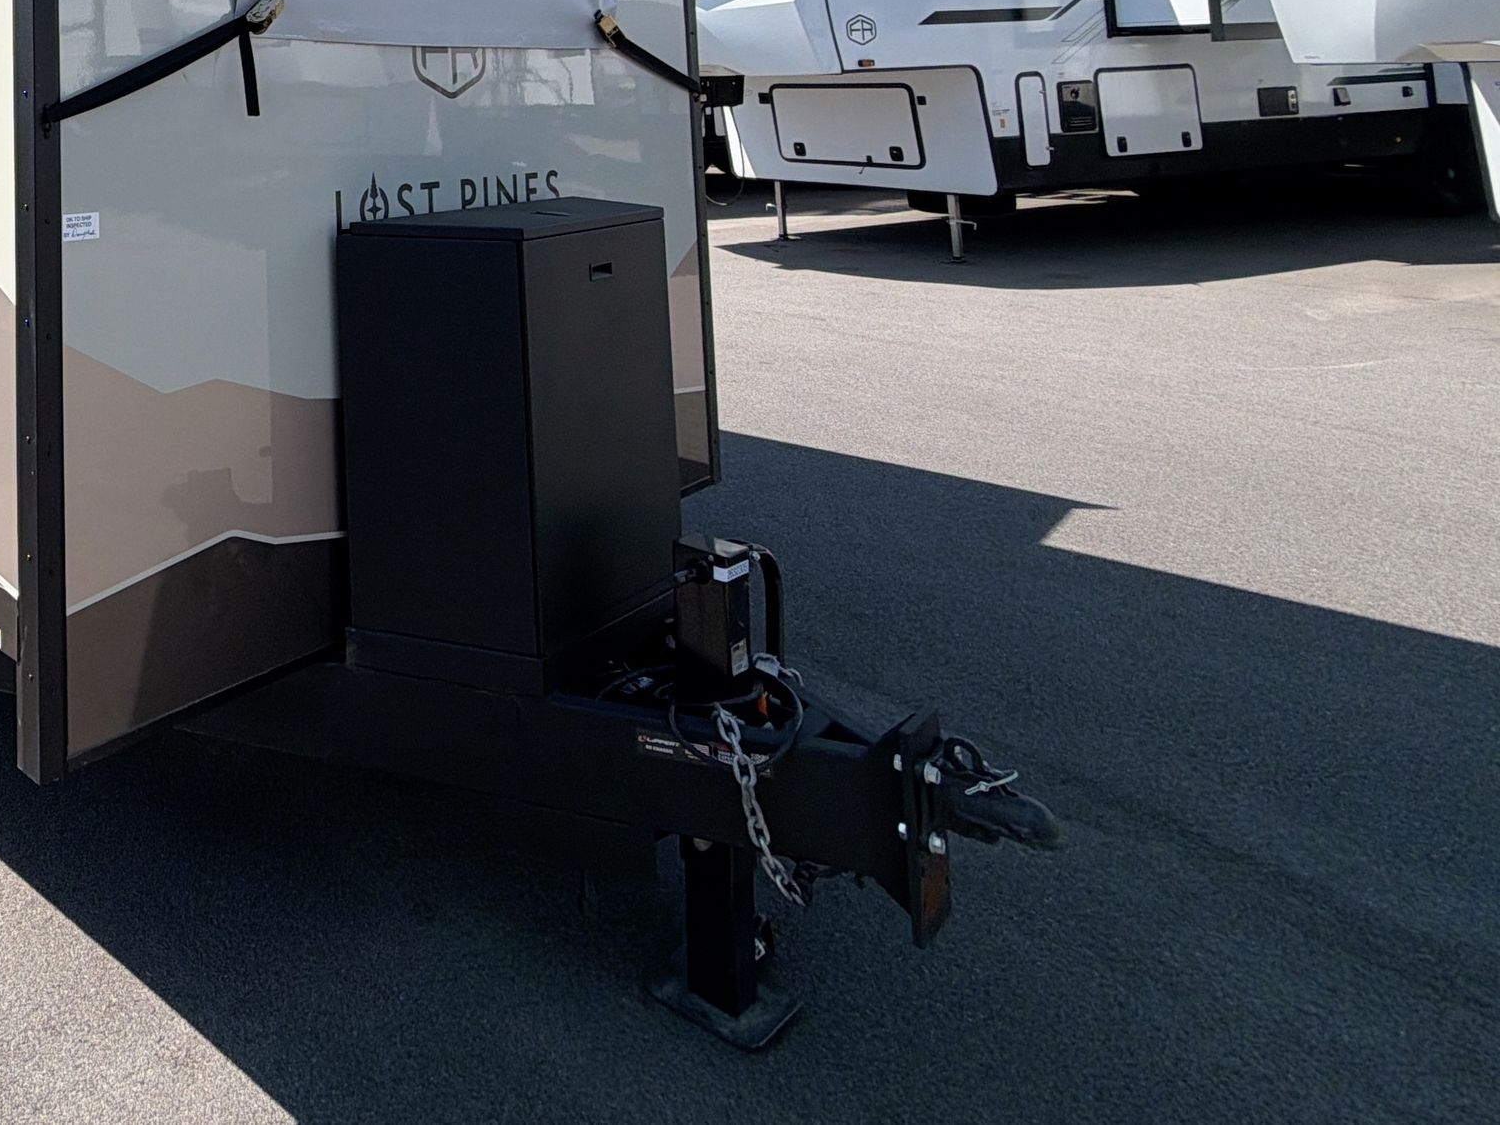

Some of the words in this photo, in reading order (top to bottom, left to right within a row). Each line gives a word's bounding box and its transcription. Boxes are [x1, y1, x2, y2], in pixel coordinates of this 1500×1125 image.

[335, 171, 441, 236] LOST
[460, 169, 561, 210] PINES
[66, 221, 92, 229] INSPECTED
